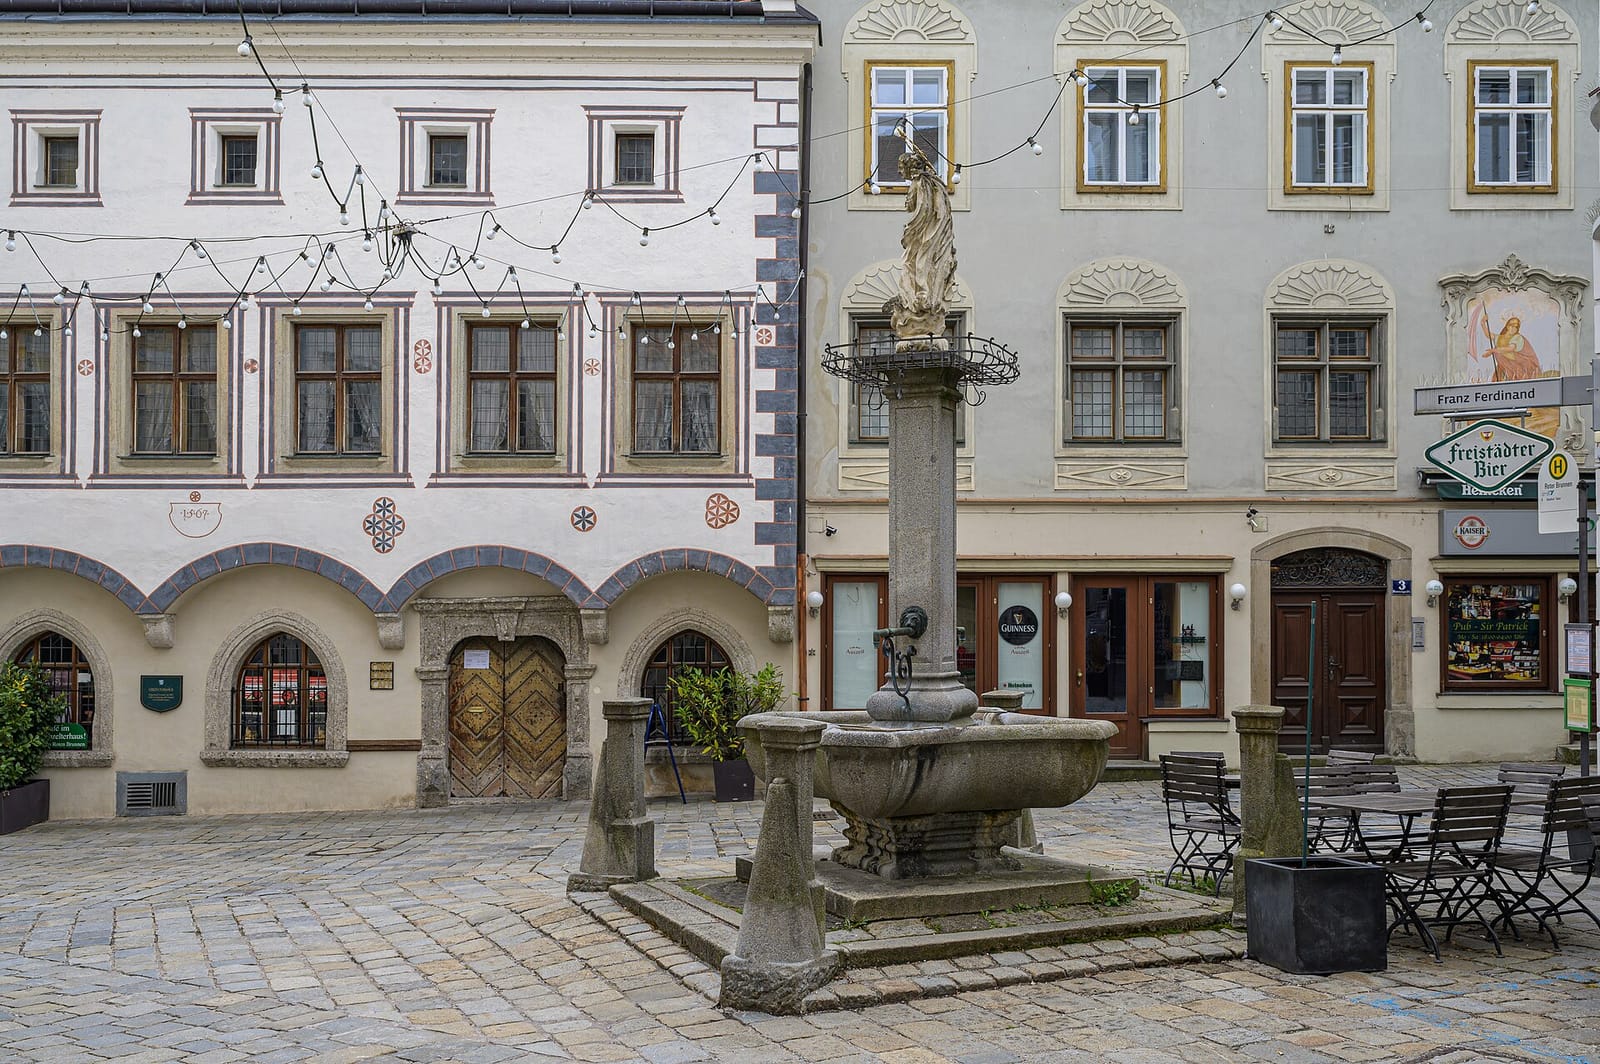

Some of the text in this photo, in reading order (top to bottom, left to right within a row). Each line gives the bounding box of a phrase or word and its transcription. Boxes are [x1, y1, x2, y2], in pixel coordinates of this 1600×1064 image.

[1438, 388, 1535, 405] Franz Ferdinand
[1474, 461, 1507, 478] Bier
[1462, 484, 1523, 496] Heken
[1460, 527, 1485, 535] KAISER
[1398, 580, 1406, 591] 3
[1001, 623, 1035, 633] GUINNESS
[1453, 621, 1471, 631] Pub
[1480, 621, 1494, 631] Sir
[1496, 621, 1528, 631] Patrick
